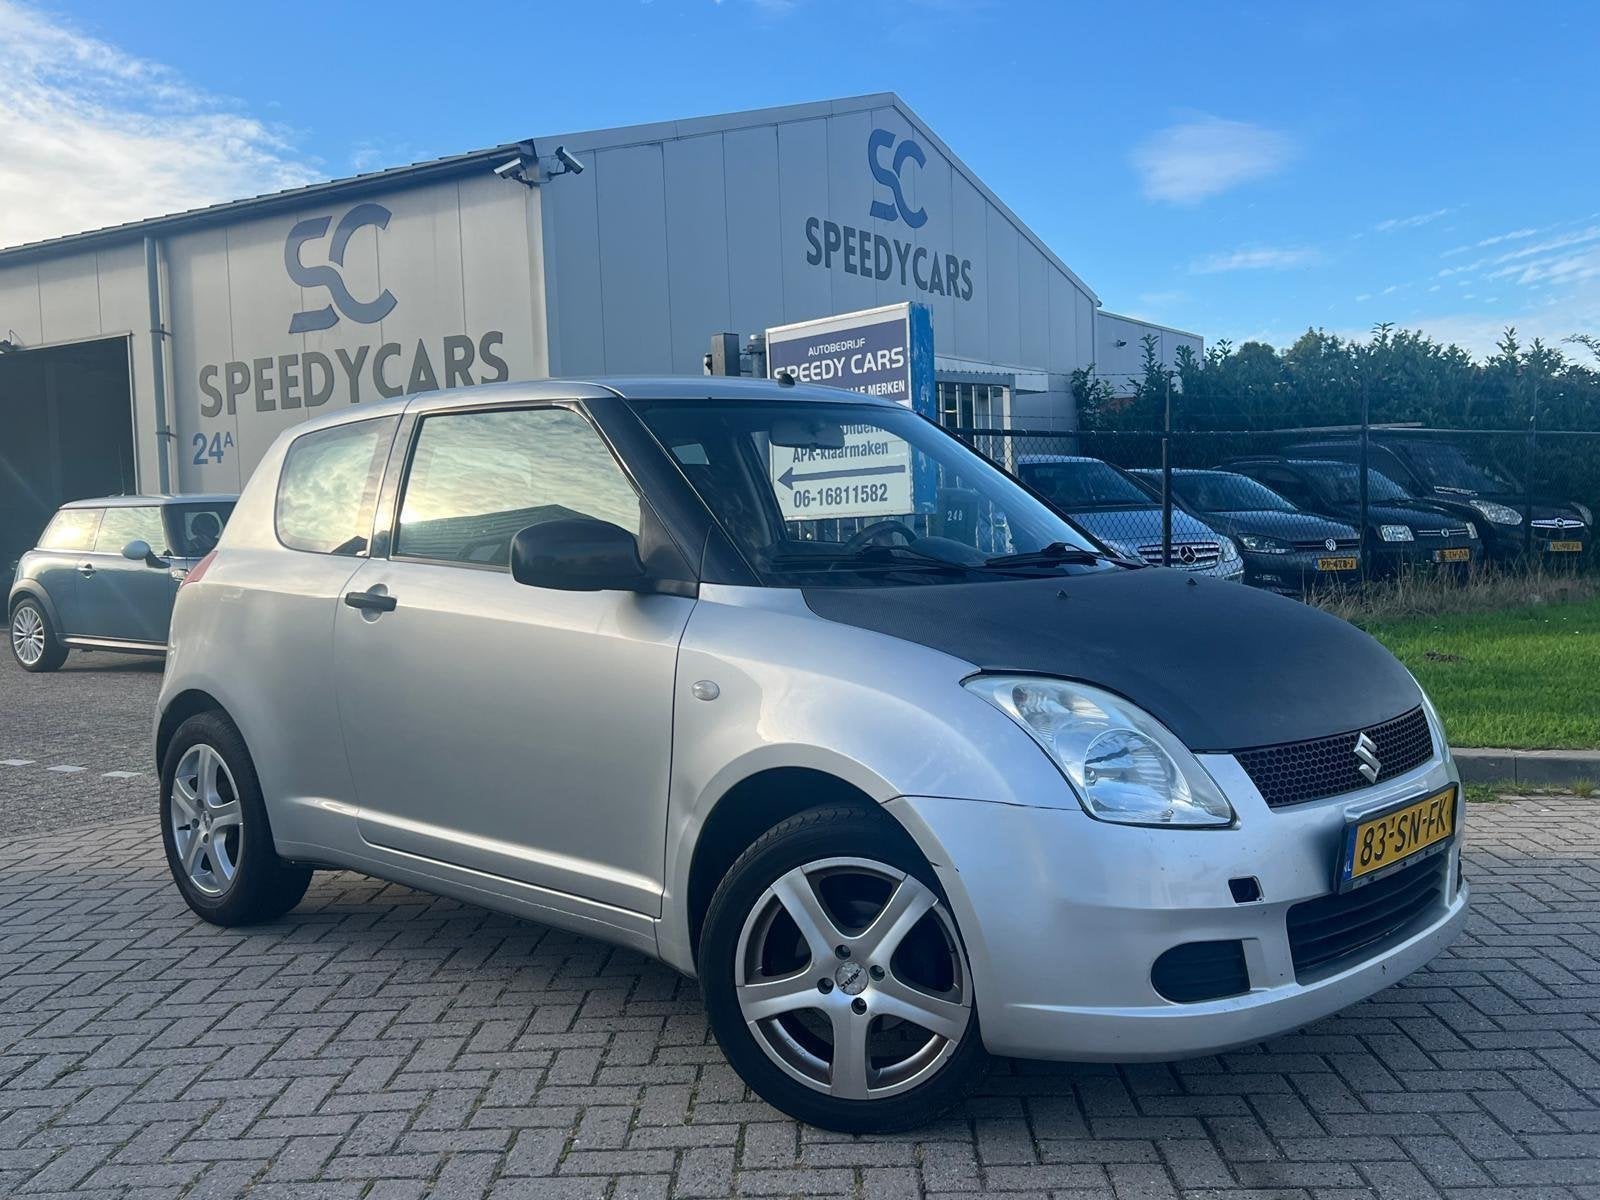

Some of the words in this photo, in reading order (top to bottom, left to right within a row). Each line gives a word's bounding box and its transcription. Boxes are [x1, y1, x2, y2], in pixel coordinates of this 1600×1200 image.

[805, 216, 973, 301] SPEEDYCARS
[807, 338, 866, 357] AUTOBEDRIJF
[199, 330, 509, 418] SPEEDYCARS
[773, 356, 846, 383] SPEEDY
[850, 346, 905, 374] CARS
[868, 379, 905, 396] MERKEN
[793, 440, 888, 463] APK-klaarmaken
[793, 483, 888, 508] 06-16811582
[1360, 797, 1448, 866] 83-SN-FK
